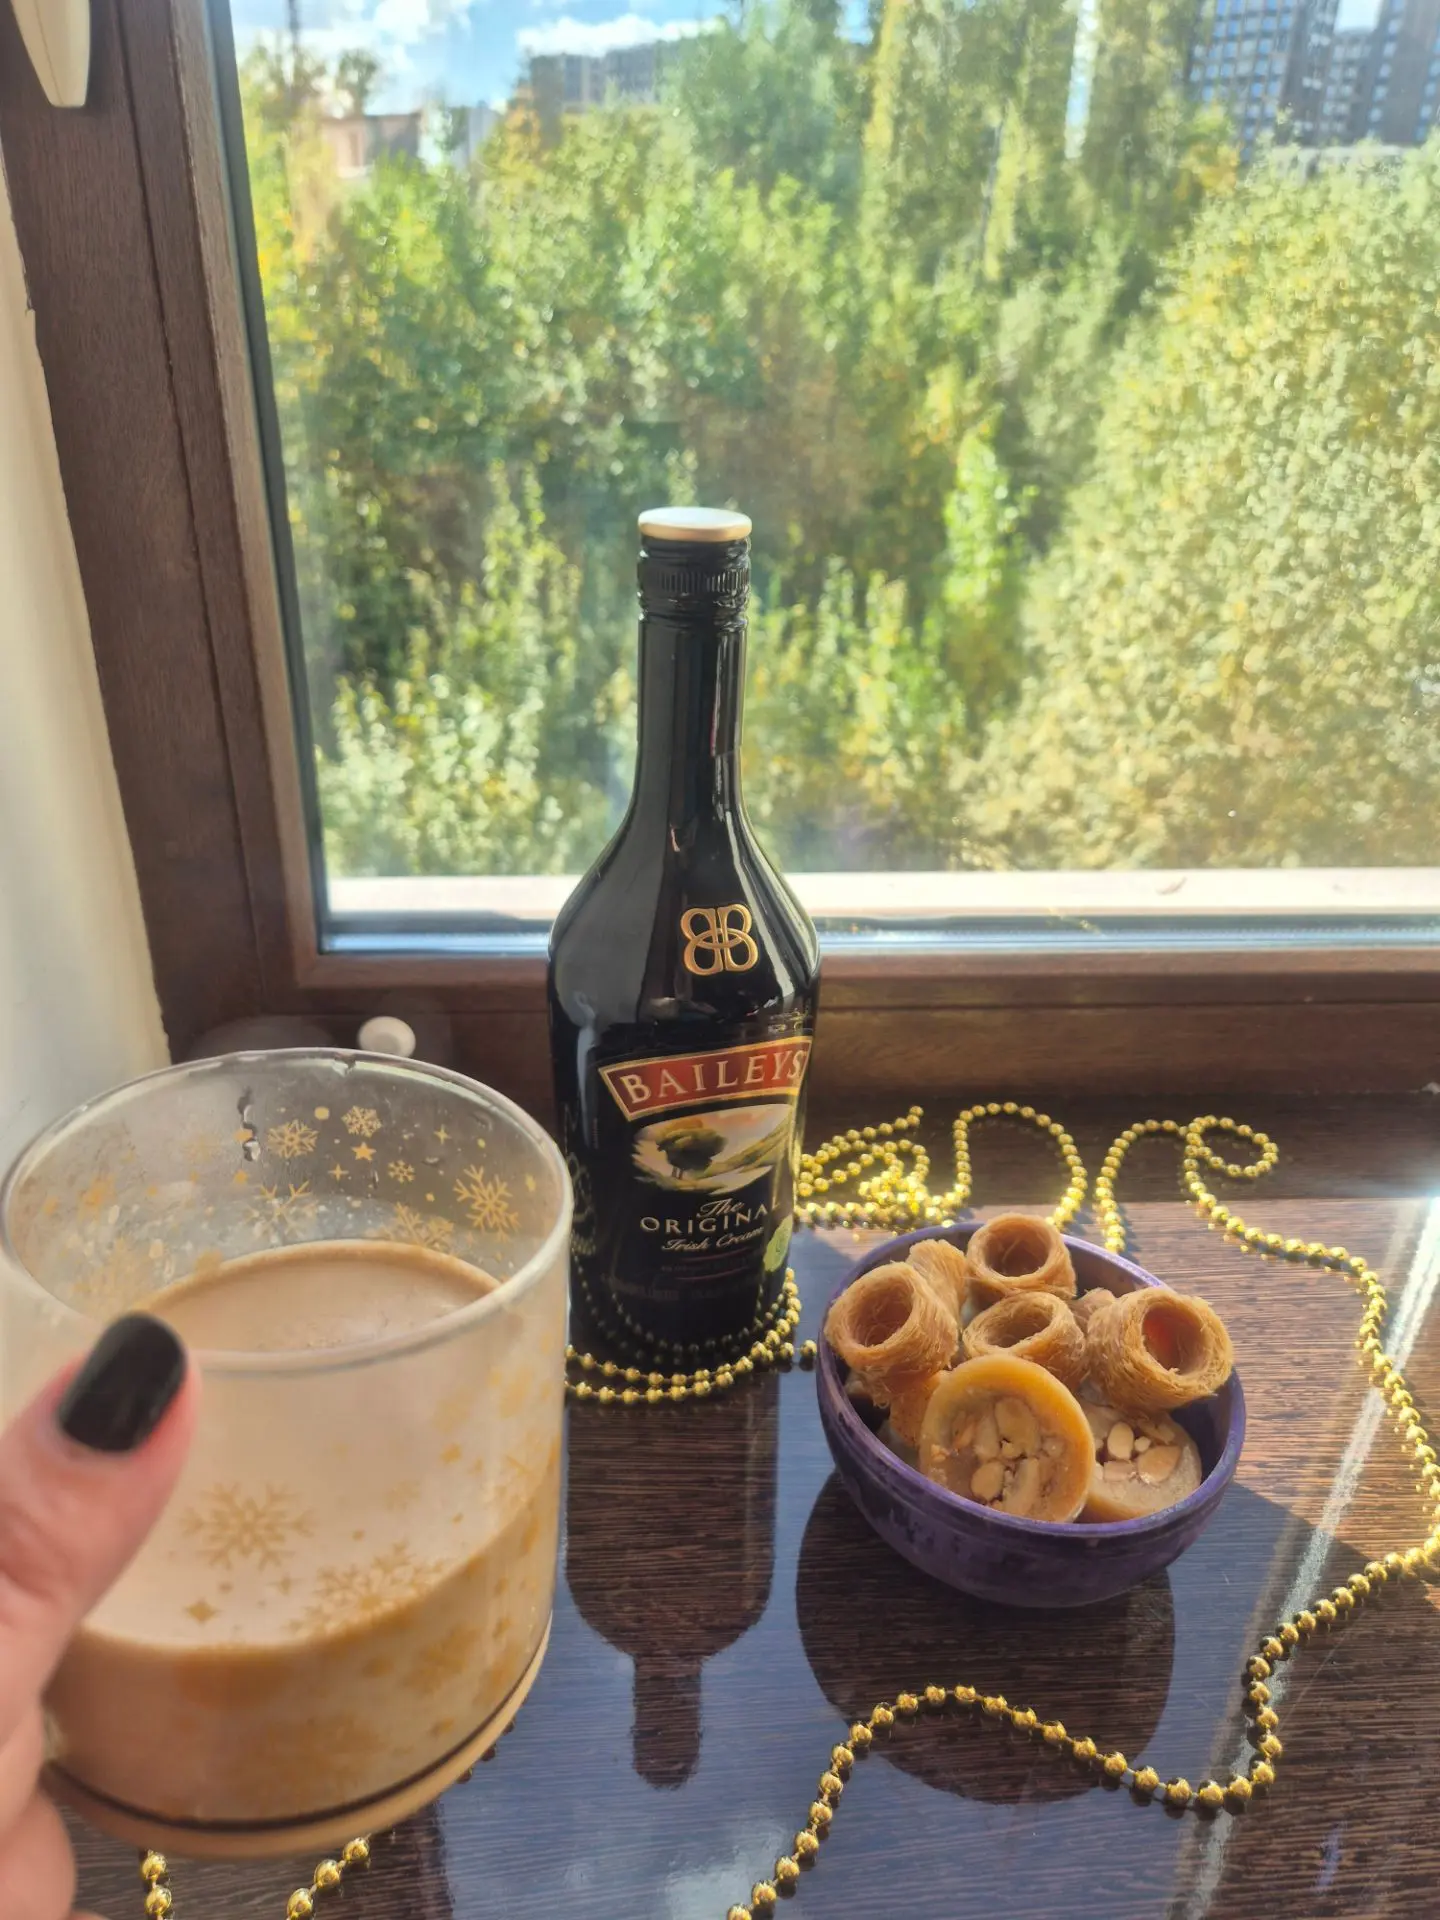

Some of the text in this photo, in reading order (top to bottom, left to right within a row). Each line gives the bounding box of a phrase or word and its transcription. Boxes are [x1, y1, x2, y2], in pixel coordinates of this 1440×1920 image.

[619, 1050, 808, 1104] BAILEYS
[696, 1198, 745, 1219] The
[661, 1236, 711, 1251] Irish
